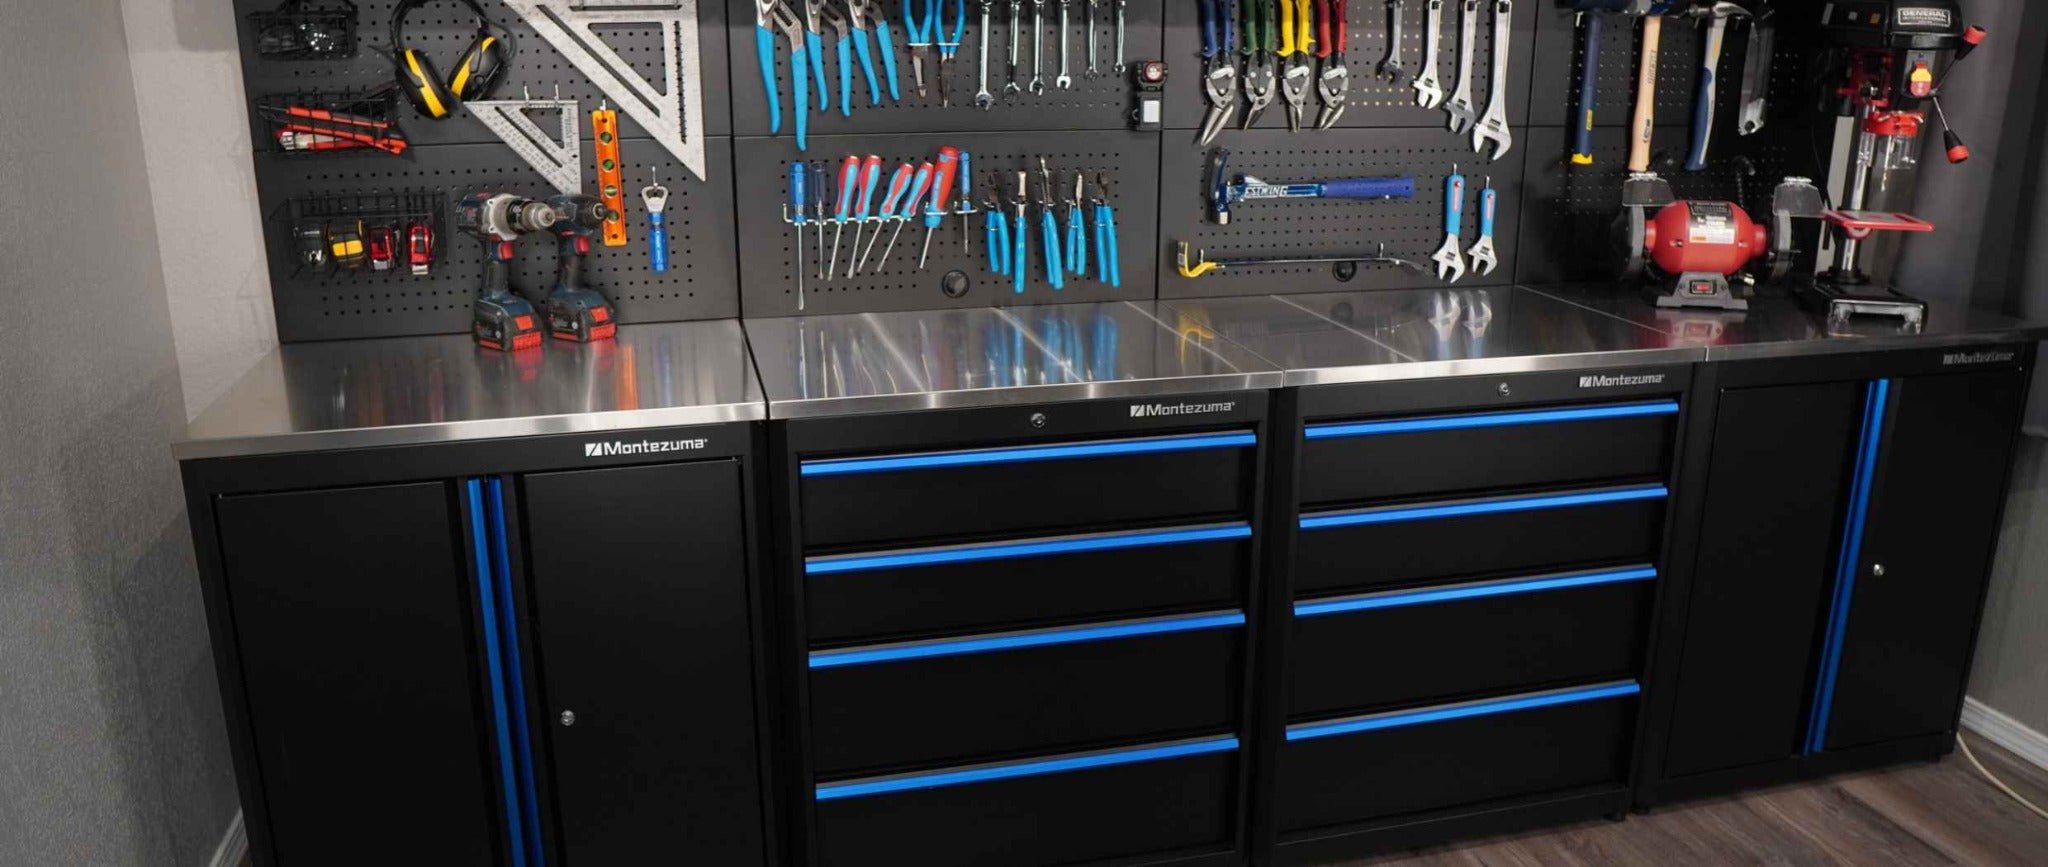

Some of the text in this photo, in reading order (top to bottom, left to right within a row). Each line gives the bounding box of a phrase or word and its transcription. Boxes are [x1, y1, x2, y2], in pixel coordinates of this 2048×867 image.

[1593, 374, 1663, 387] Montezuma
[1146, 402, 1233, 417] Montezuma
[603, 439, 705, 455] Montezuma
